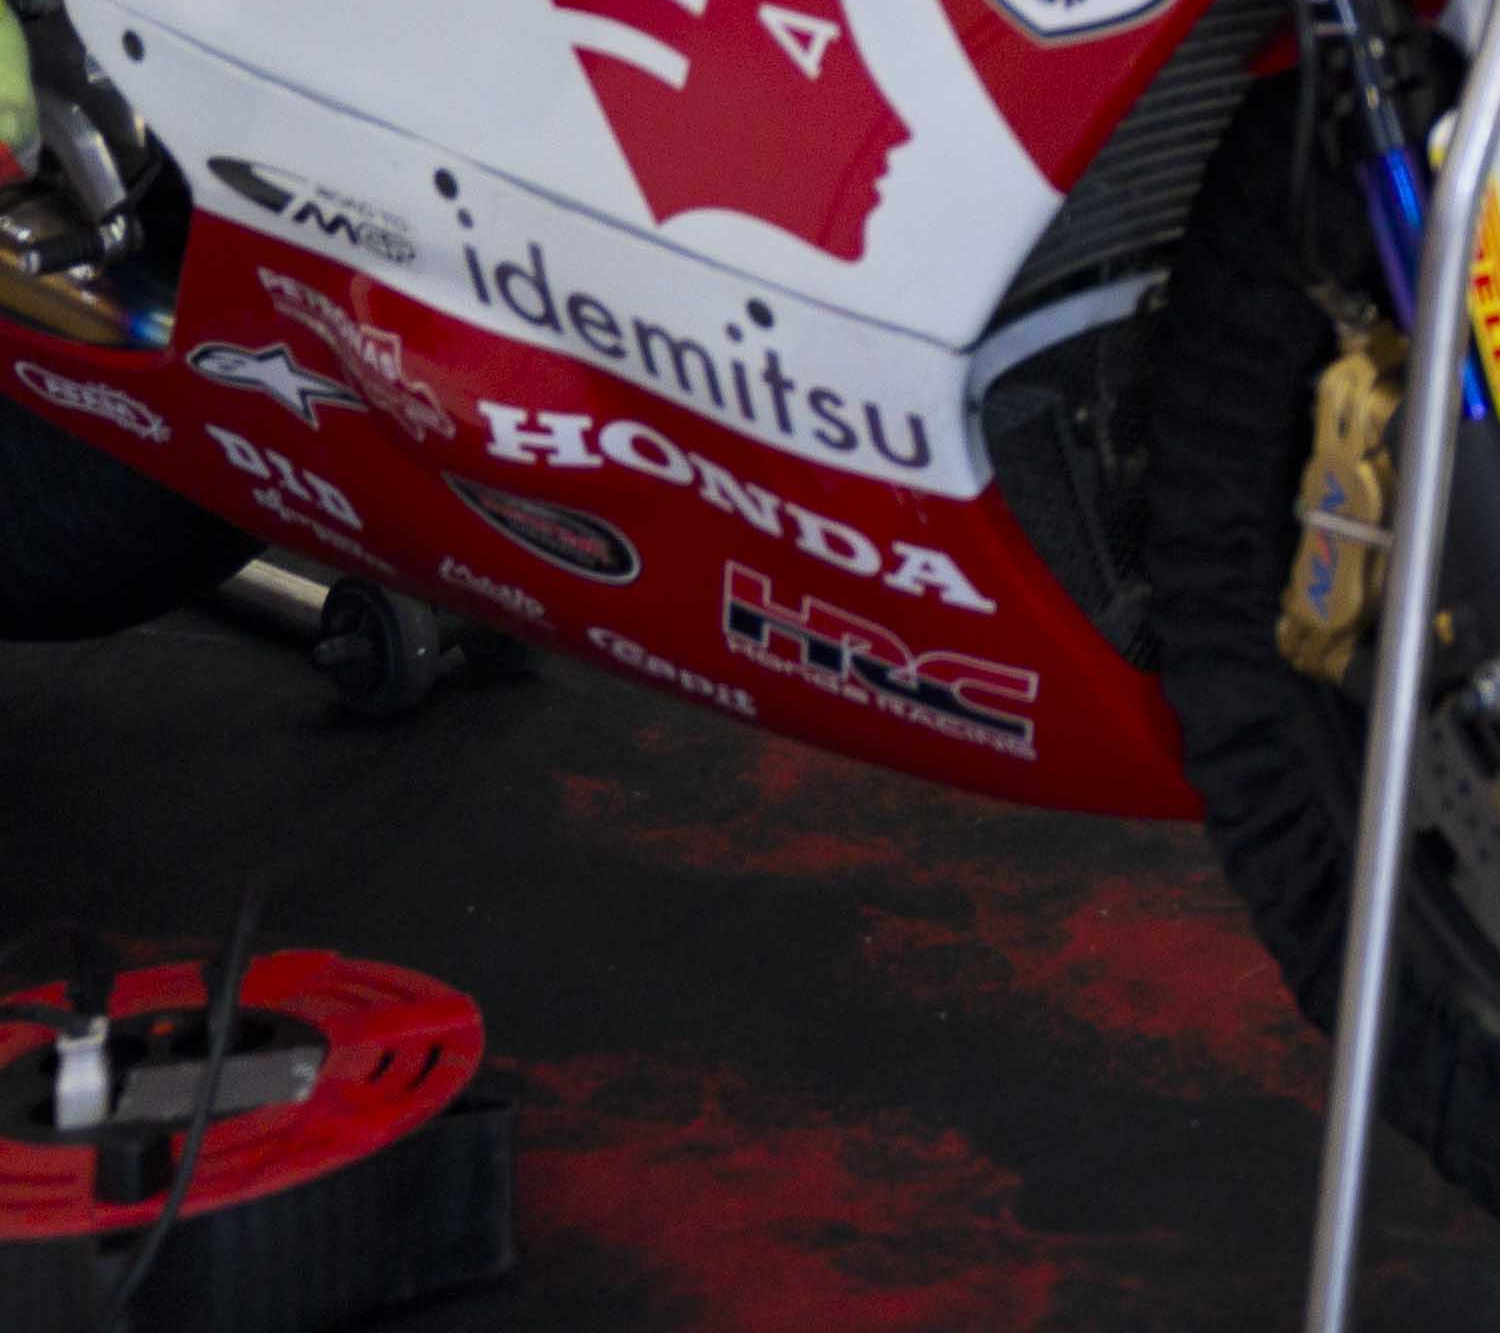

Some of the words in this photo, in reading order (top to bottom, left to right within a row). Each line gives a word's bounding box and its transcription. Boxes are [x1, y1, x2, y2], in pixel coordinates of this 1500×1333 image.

[458, 209, 932, 471] idemitsu
[478, 400, 996, 614] HONDA
[722, 561, 1039, 740] HRC
